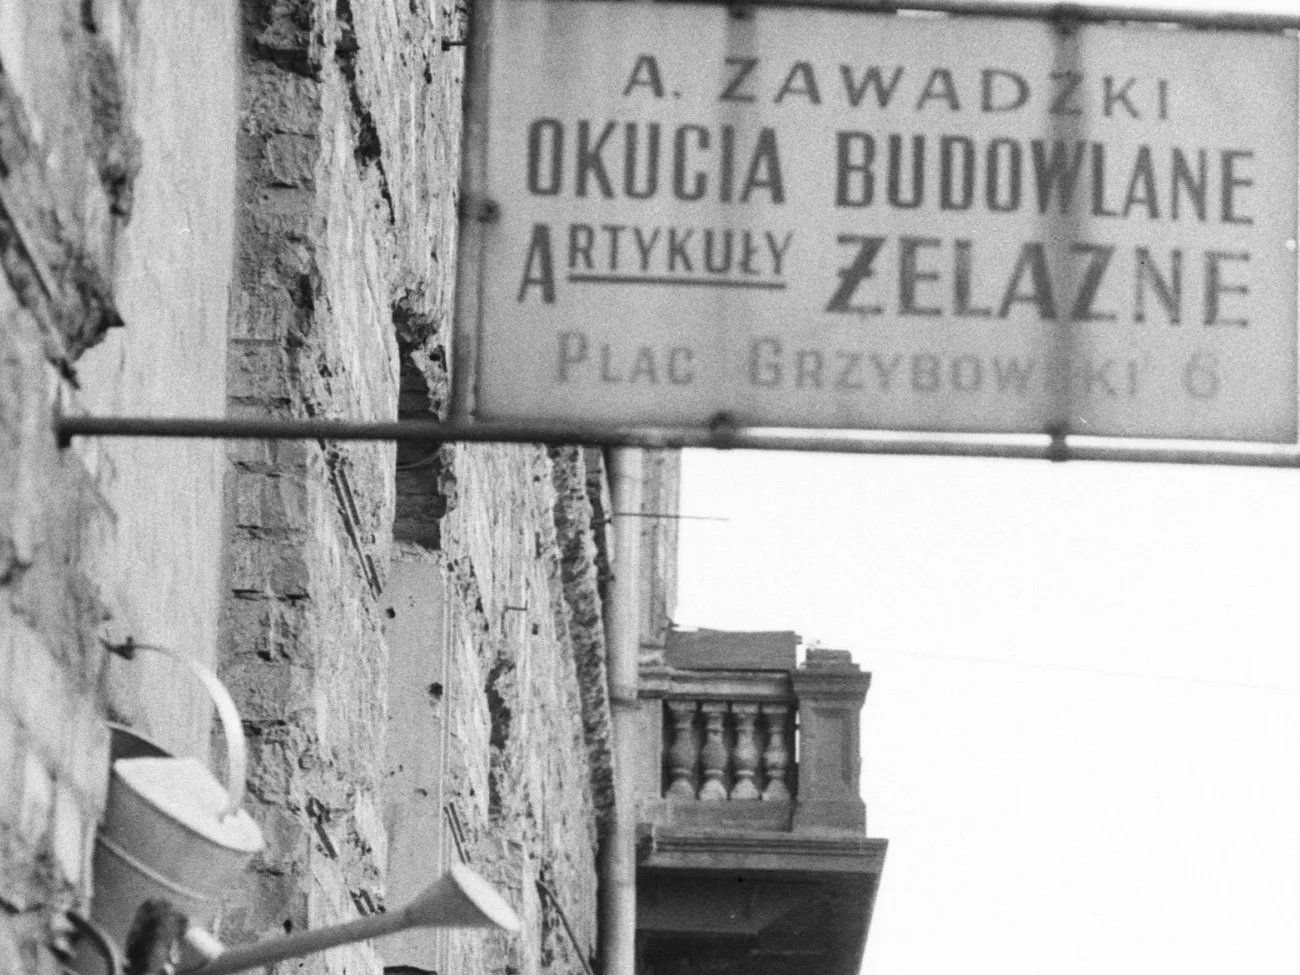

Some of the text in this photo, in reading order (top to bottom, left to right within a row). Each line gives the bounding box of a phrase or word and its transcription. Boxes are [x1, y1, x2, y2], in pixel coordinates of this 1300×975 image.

[622, 53, 1168, 120] A. ZAWADZKI
[527, 116, 1254, 225] OKUCIA BUDOWLANE
[517, 223, 793, 304] ARTYKUŁY
[556, 331, 1221, 400] PLAC GRZYBOWKI 6
